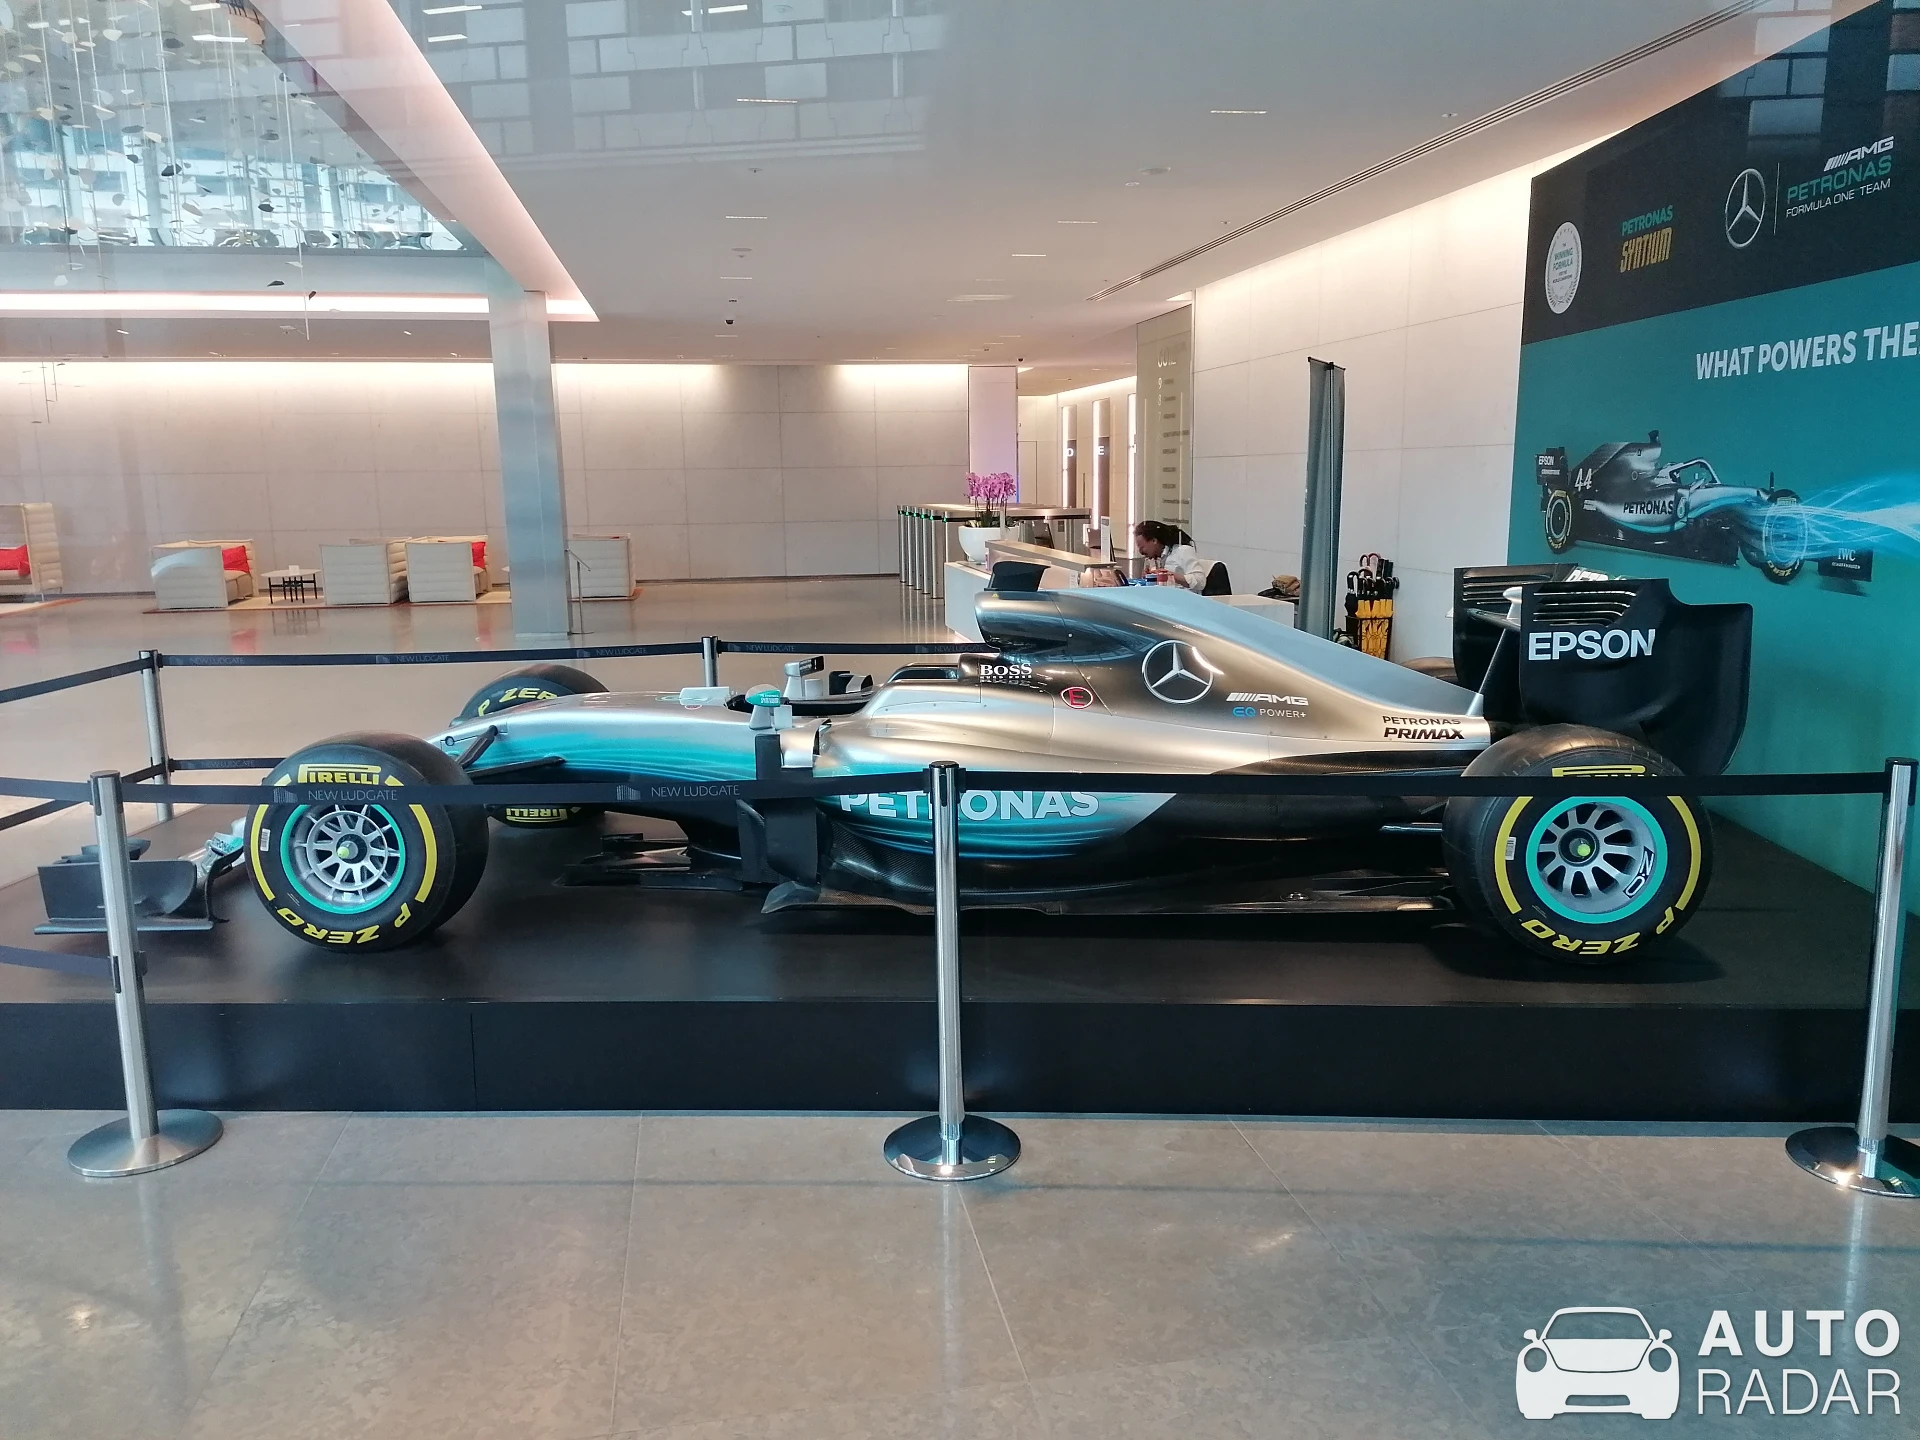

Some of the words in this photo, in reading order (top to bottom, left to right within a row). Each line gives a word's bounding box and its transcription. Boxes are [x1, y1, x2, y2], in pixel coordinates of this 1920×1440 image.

[1843, 136, 1894, 165] AMG
[1787, 155, 1892, 204] PETRONAS
[1786, 198, 1832, 219] FORMULA
[1833, 189, 1855, 205] ONE
[1860, 178, 1891, 196] TEAM
[1622, 205, 1673, 236] PETRONAS
[1620, 227, 1672, 273] SYNTIUM
[1696, 345, 1754, 380] WHAT
[1758, 331, 1857, 373] POWERS
[1863, 321, 1920, 361] THE
[1538, 455, 1555, 466] EPSON
[1575, 468, 1593, 491] 44
[1623, 500, 1674, 515] PETRONAS
[1837, 548, 1856, 562] IWC
[1528, 628, 1656, 661] EPSON
[980, 663, 1032, 676] BOSS
[478, 699, 490, 717] P
[499, 687, 558, 703] ZER
[1068, 689, 1085, 706] E
[1232, 706, 1257, 718] EQ
[1259, 708, 1307, 718] POWER+
[1382, 715, 1461, 726] PETRONAS
[1383, 727, 1465, 740] PRIMAX
[297, 763, 382, 785] PIRELLI
[308, 790, 339, 801] NEW
[341, 789, 398, 801] LUDGATE
[651, 787, 681, 798] NEW
[683, 785, 740, 797] LUDGATE
[506, 807, 568, 823] PIRELLI
[840, 790, 1100, 821] PETONAS
[277, 907, 380, 944] ZERO
[394, 902, 412, 928] P
[1655, 906, 1675, 935] P
[1521, 919, 1641, 955] ZERO
